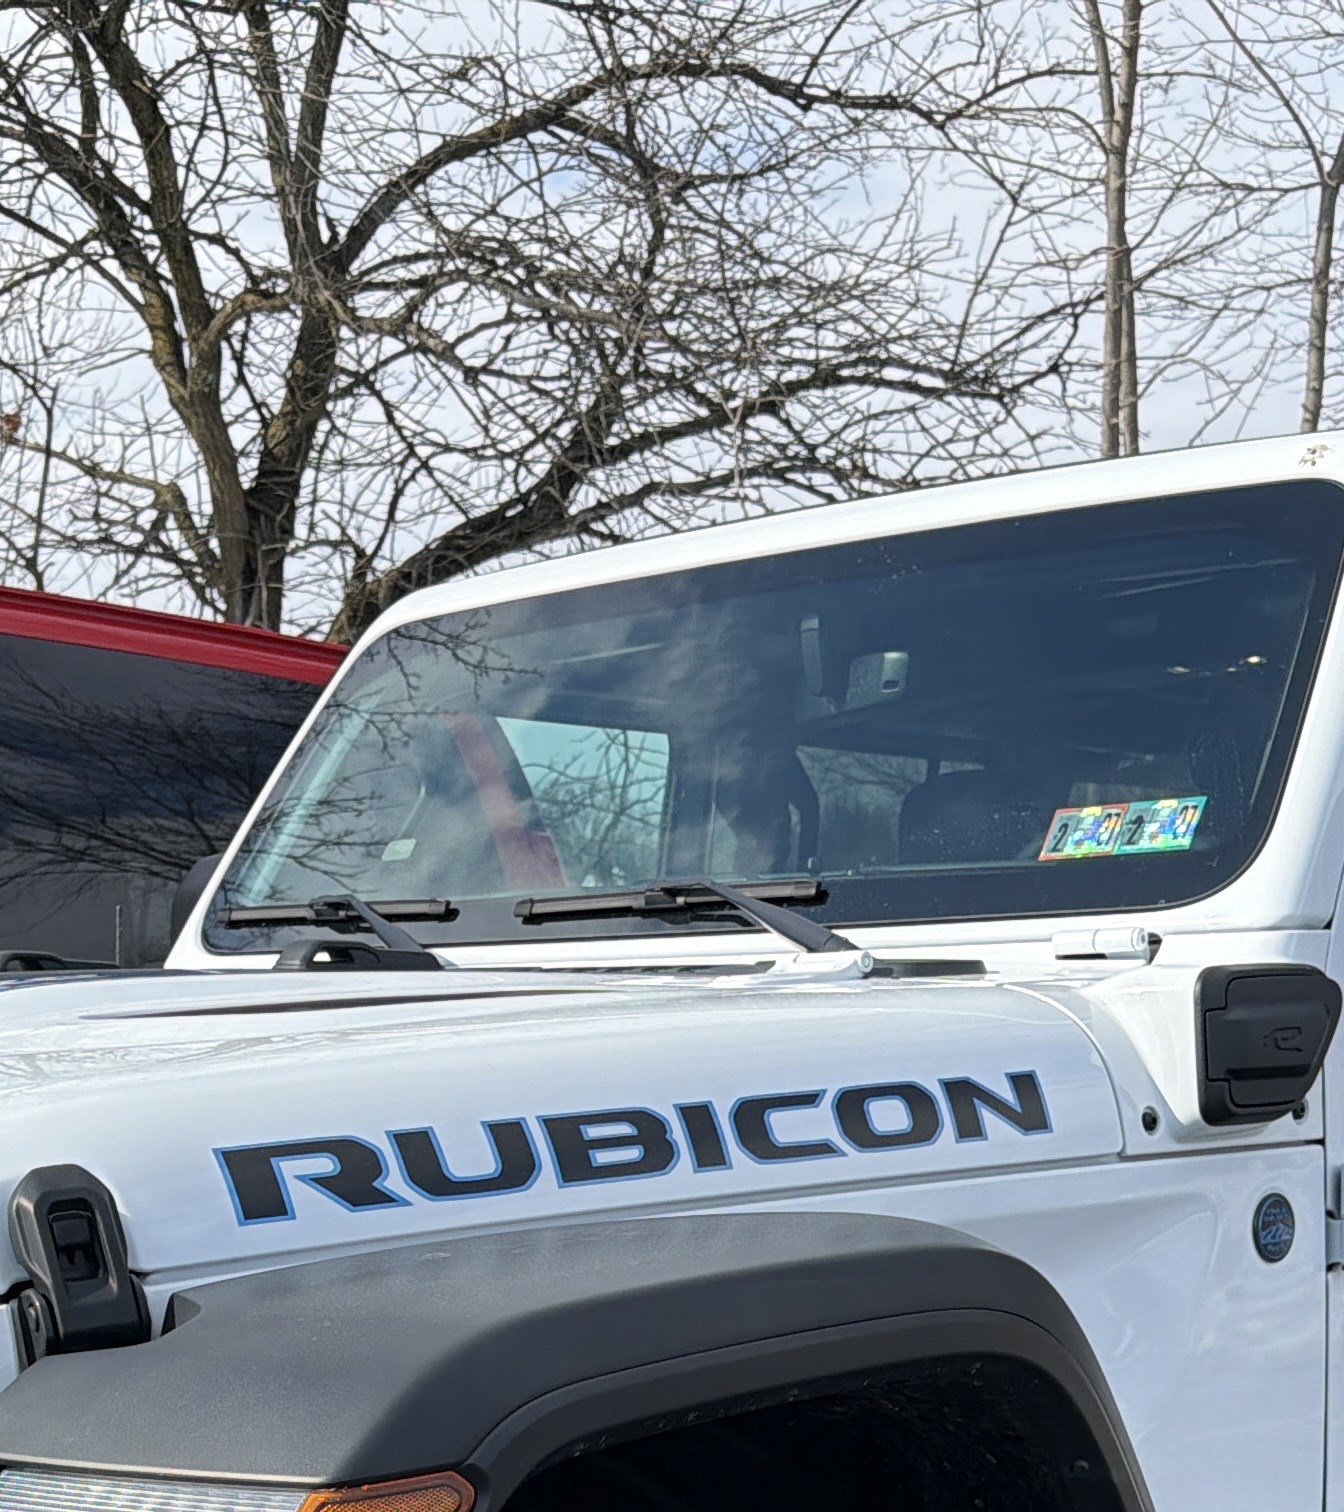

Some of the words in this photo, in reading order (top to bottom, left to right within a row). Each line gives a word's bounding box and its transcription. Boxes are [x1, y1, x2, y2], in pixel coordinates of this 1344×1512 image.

[1052, 822, 1069, 852] 2
[1125, 814, 1146, 846] 2
[212, 1069, 1053, 1228] RUBICON
